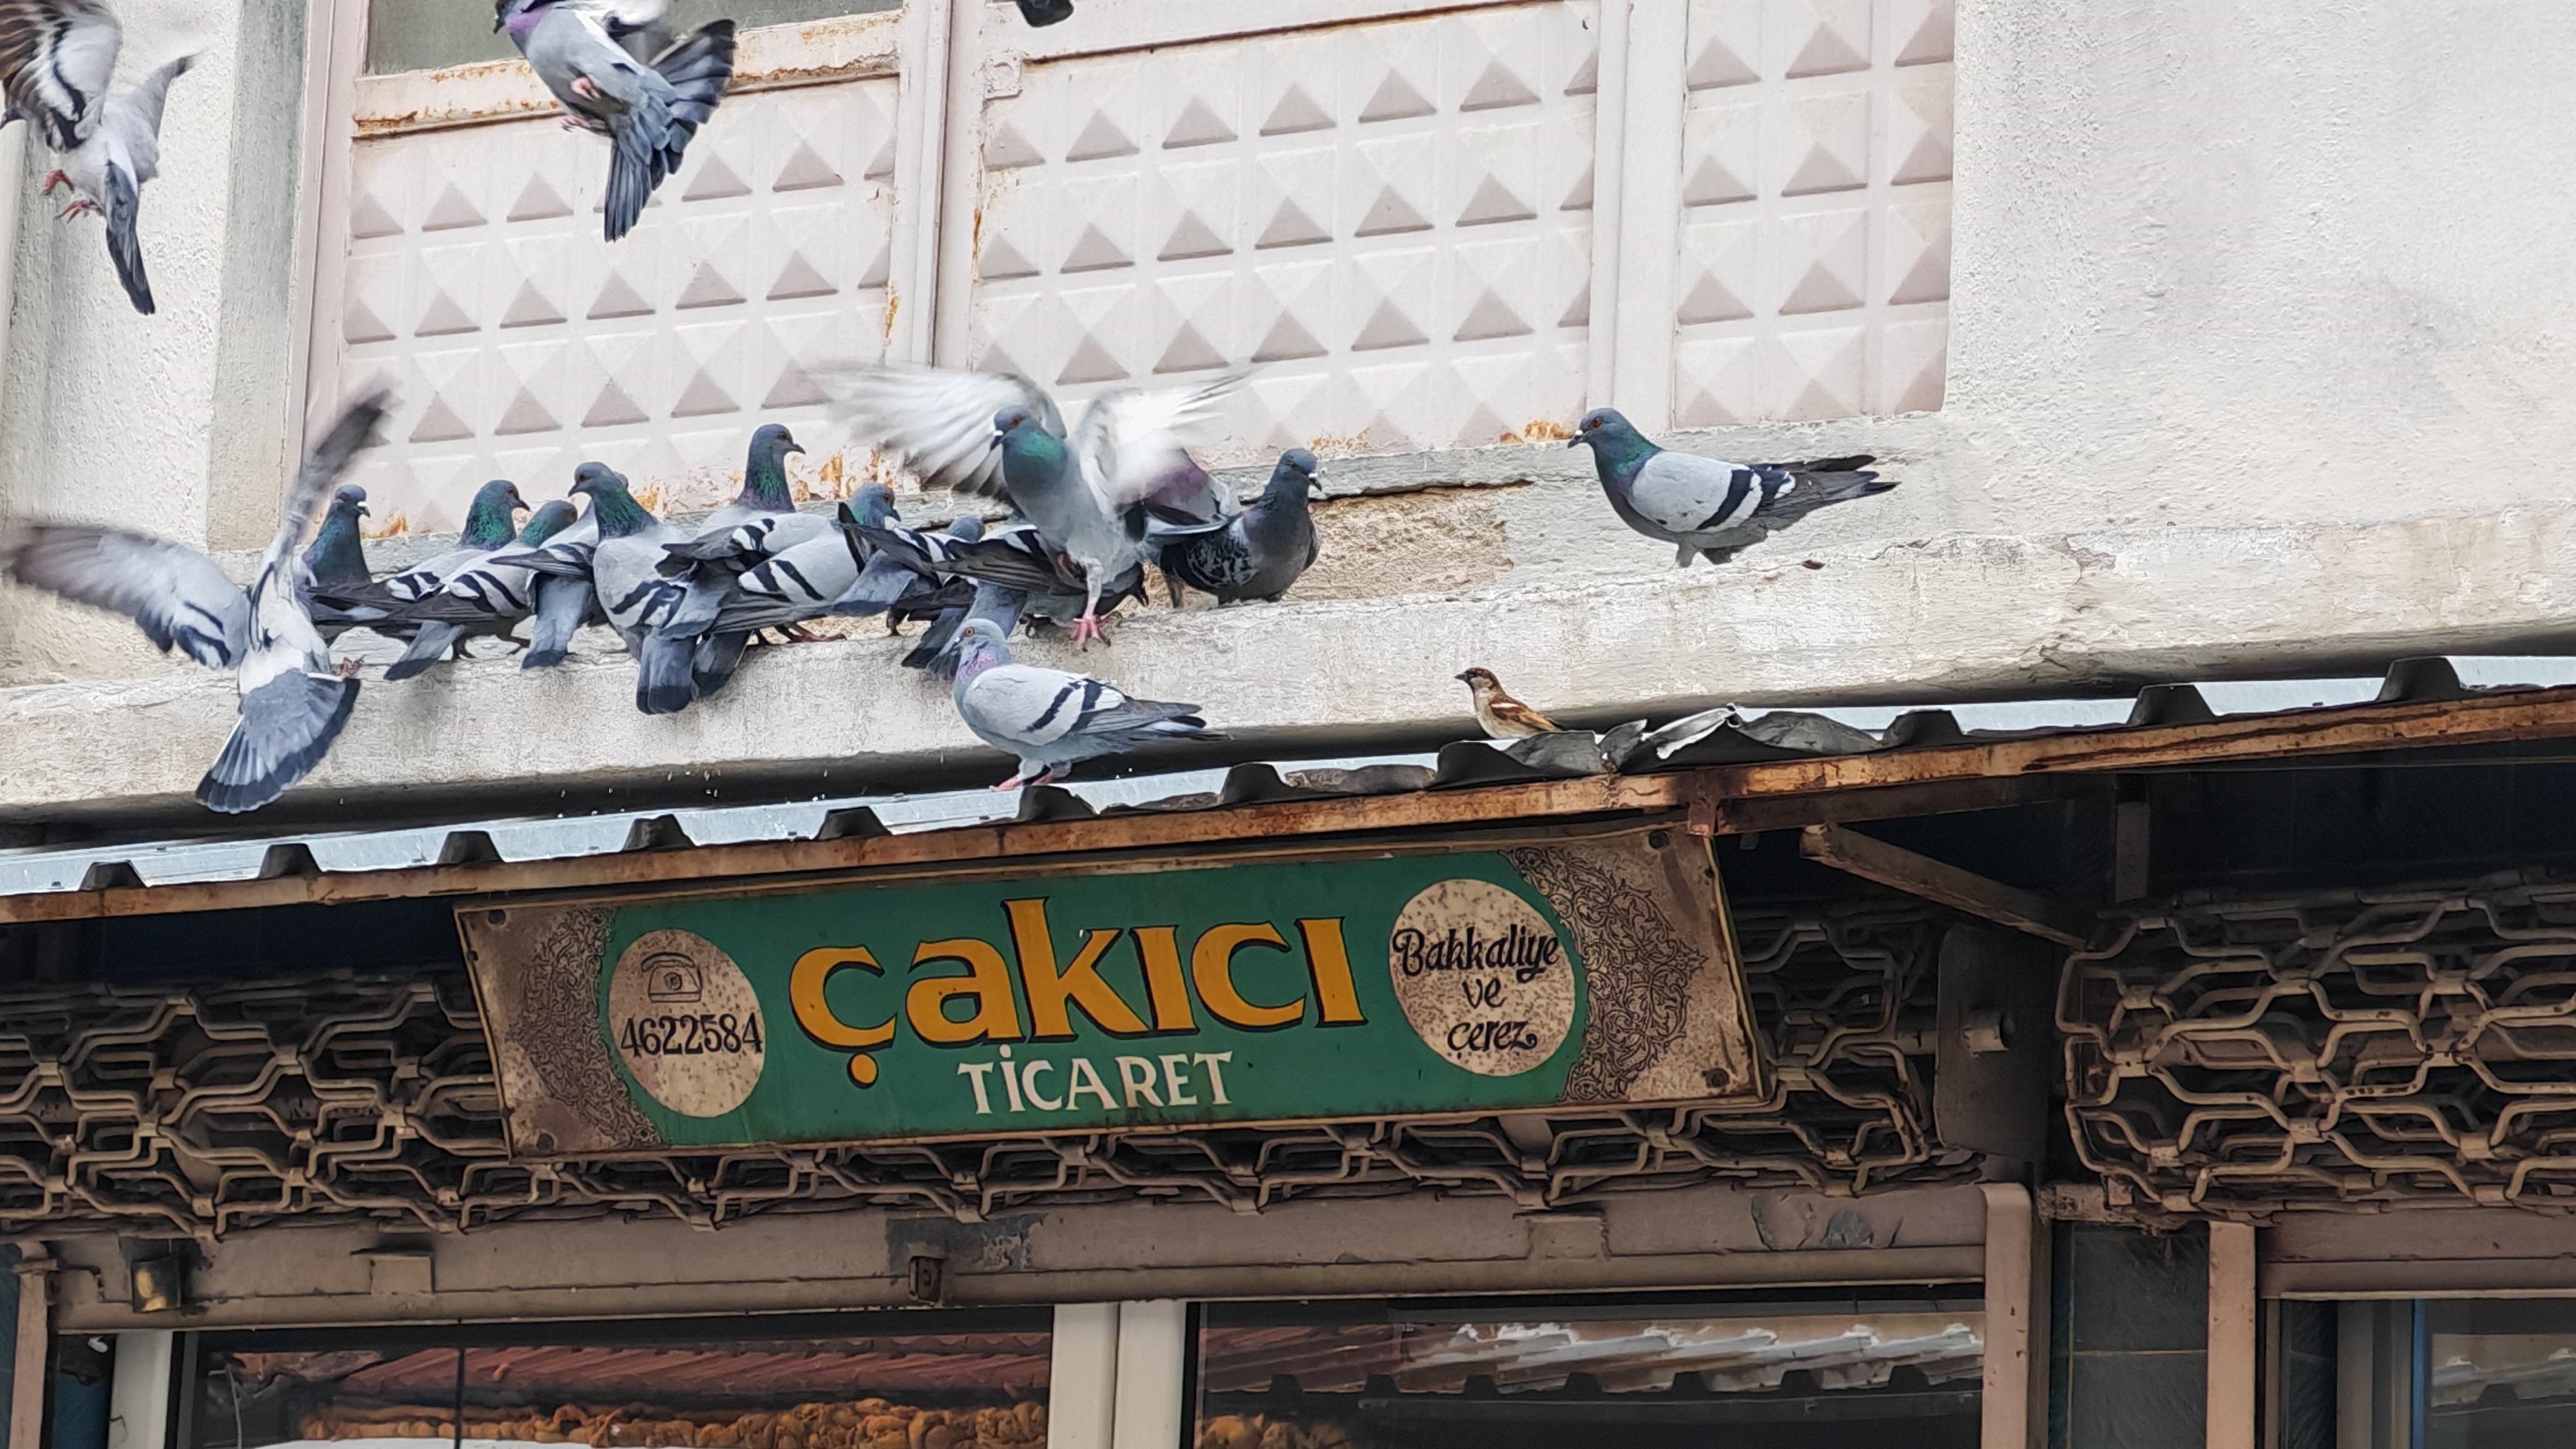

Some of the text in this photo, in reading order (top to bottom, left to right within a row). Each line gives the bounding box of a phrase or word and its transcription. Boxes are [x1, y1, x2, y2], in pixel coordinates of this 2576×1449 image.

[1392, 923, 1559, 984] Bakkaliye
[1462, 977, 1510, 1009] ve
[620, 1012, 763, 1058] 4622584
[957, 1044, 1233, 1114] TİCARET
